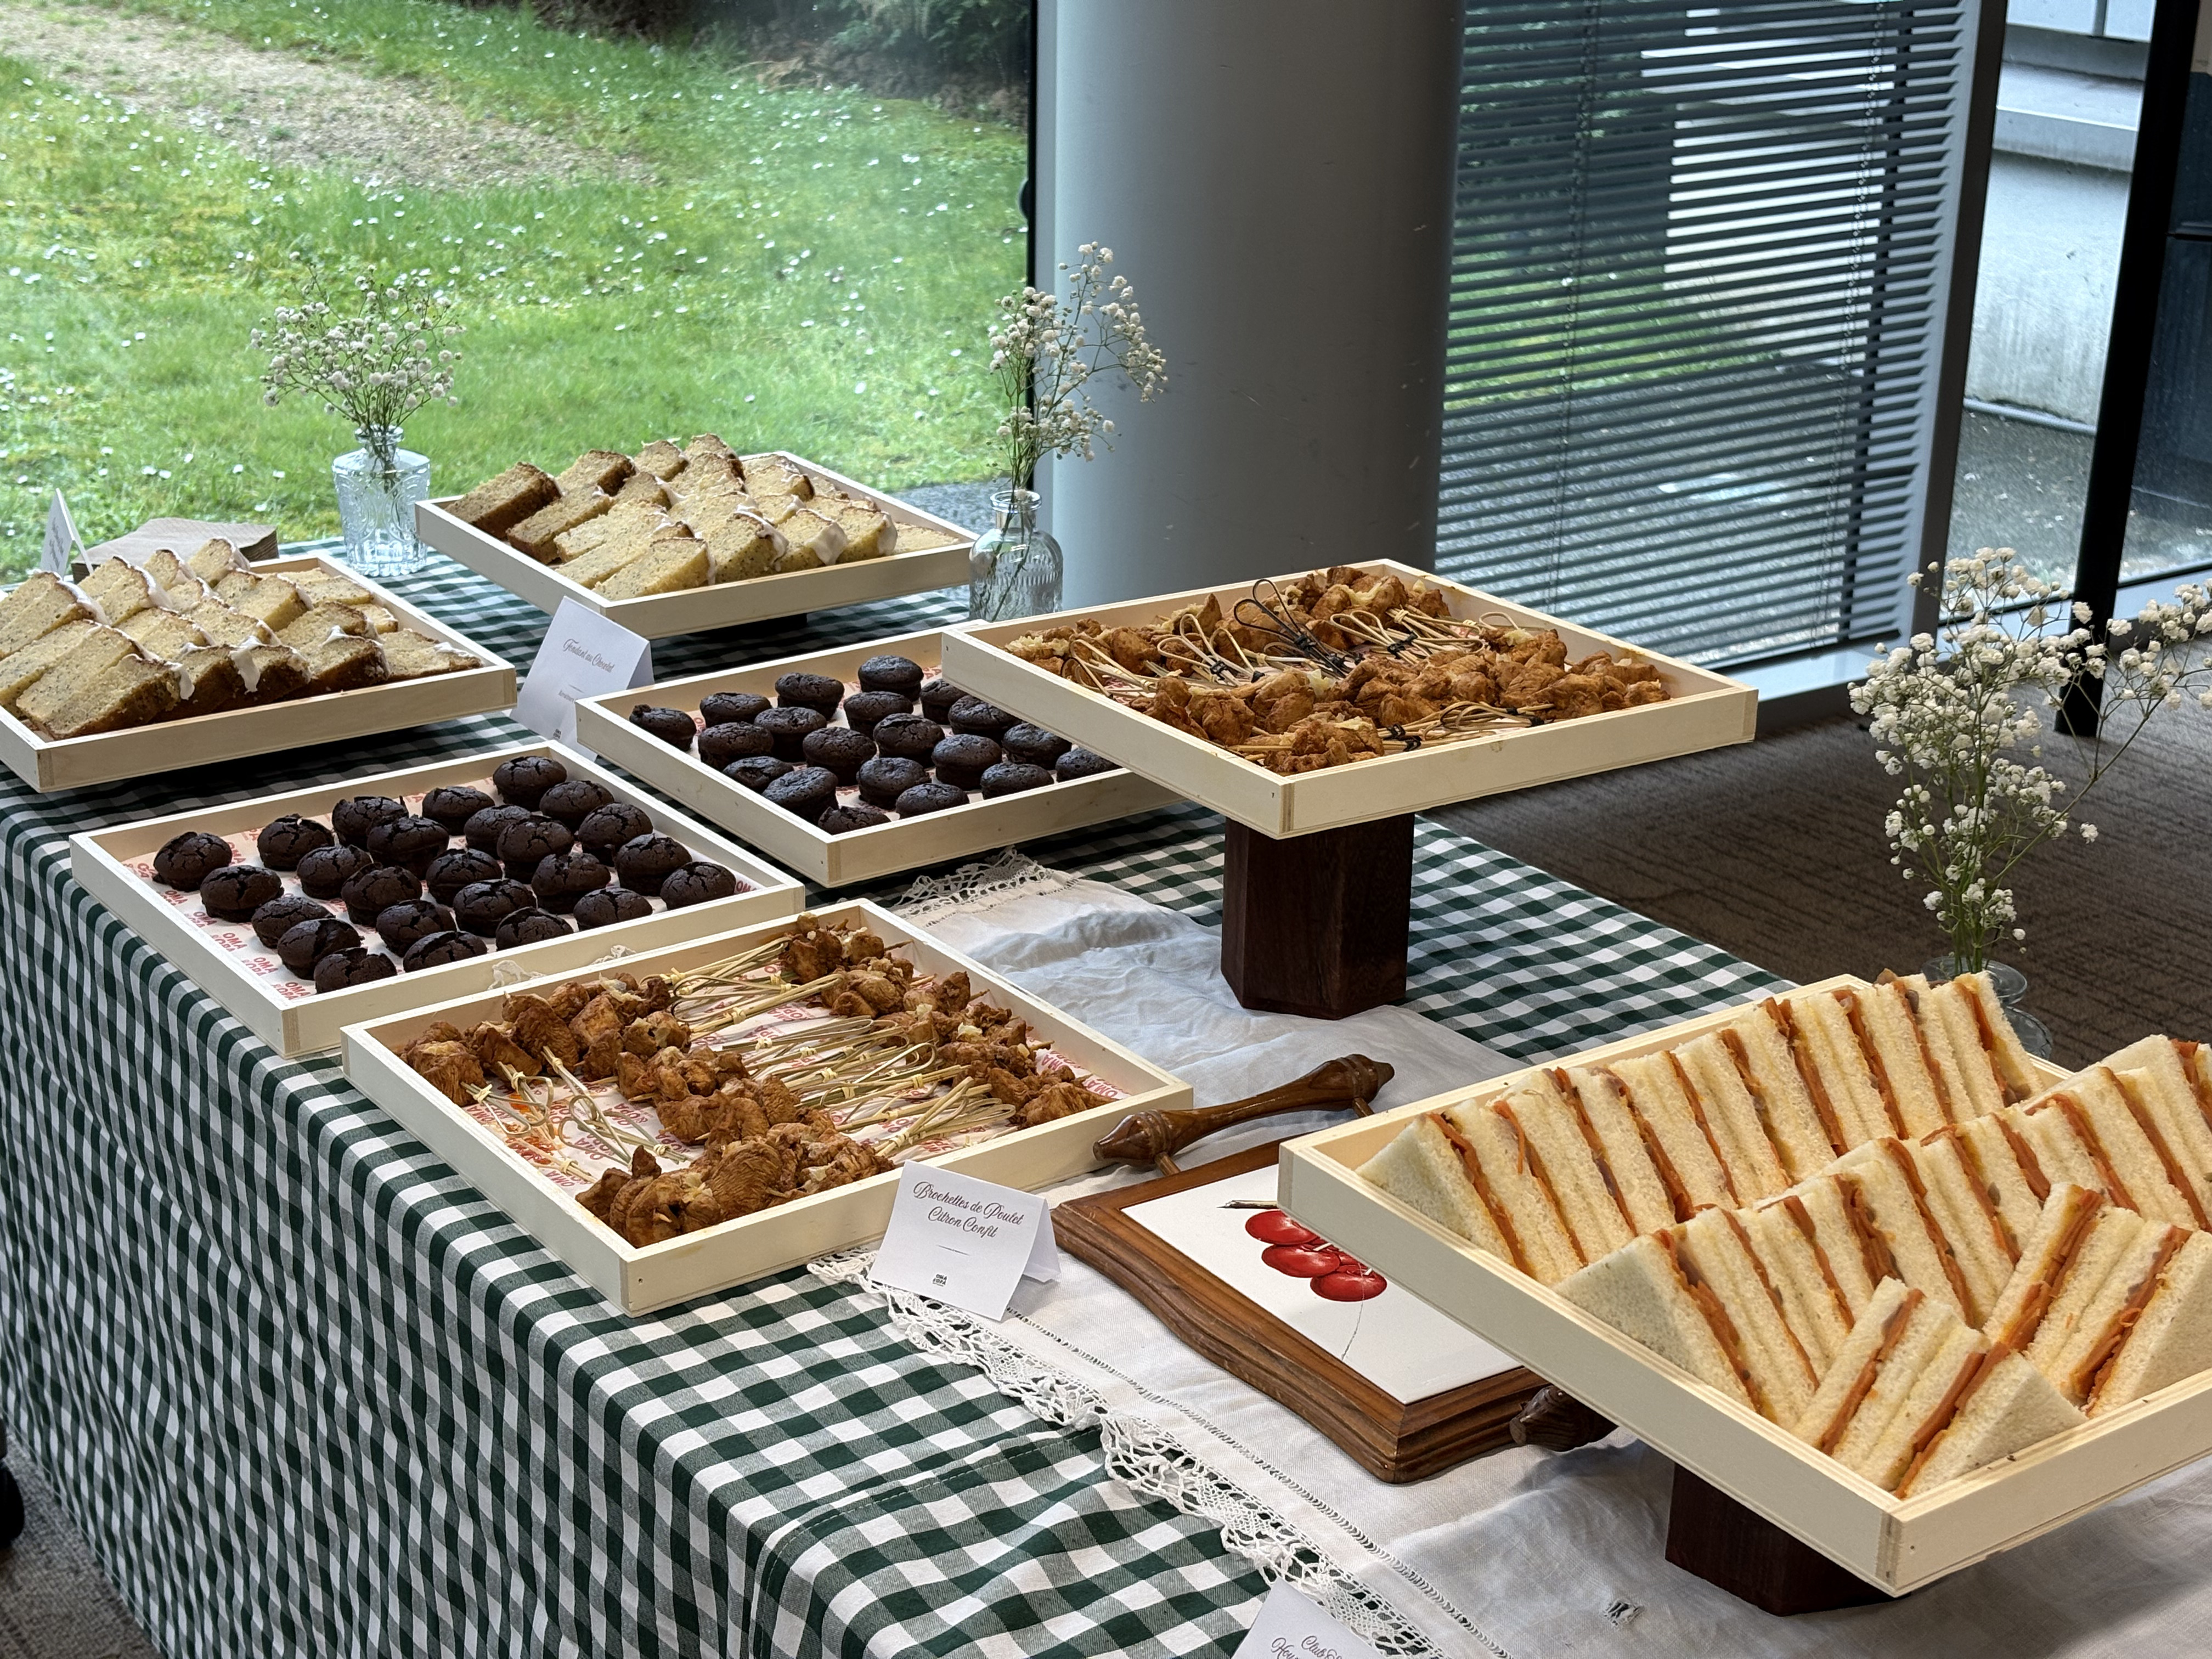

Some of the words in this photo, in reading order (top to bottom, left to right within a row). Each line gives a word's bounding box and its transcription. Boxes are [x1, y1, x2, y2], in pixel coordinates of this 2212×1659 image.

[736, 880, 757, 893] OM
[165, 890, 188, 904] OMA
[193, 911, 217, 926] OMA
[222, 933, 248, 950] OMA
[254, 957, 279, 973] OMA
[285, 982, 311, 997] OMA
[1086, 1080, 1118, 1098] OMA
[466, 1105, 495, 1122] OMA
[546, 1171, 575, 1187] OMA
[913, 1181, 969, 1209] Brochettes
[969, 1200, 983, 1213] de
[983, 1202, 1025, 1226] Poulet
[928, 1206, 962, 1227] Citron
[962, 1216, 999, 1238] Confit
[1301, 1635, 1328, 1658] Club
